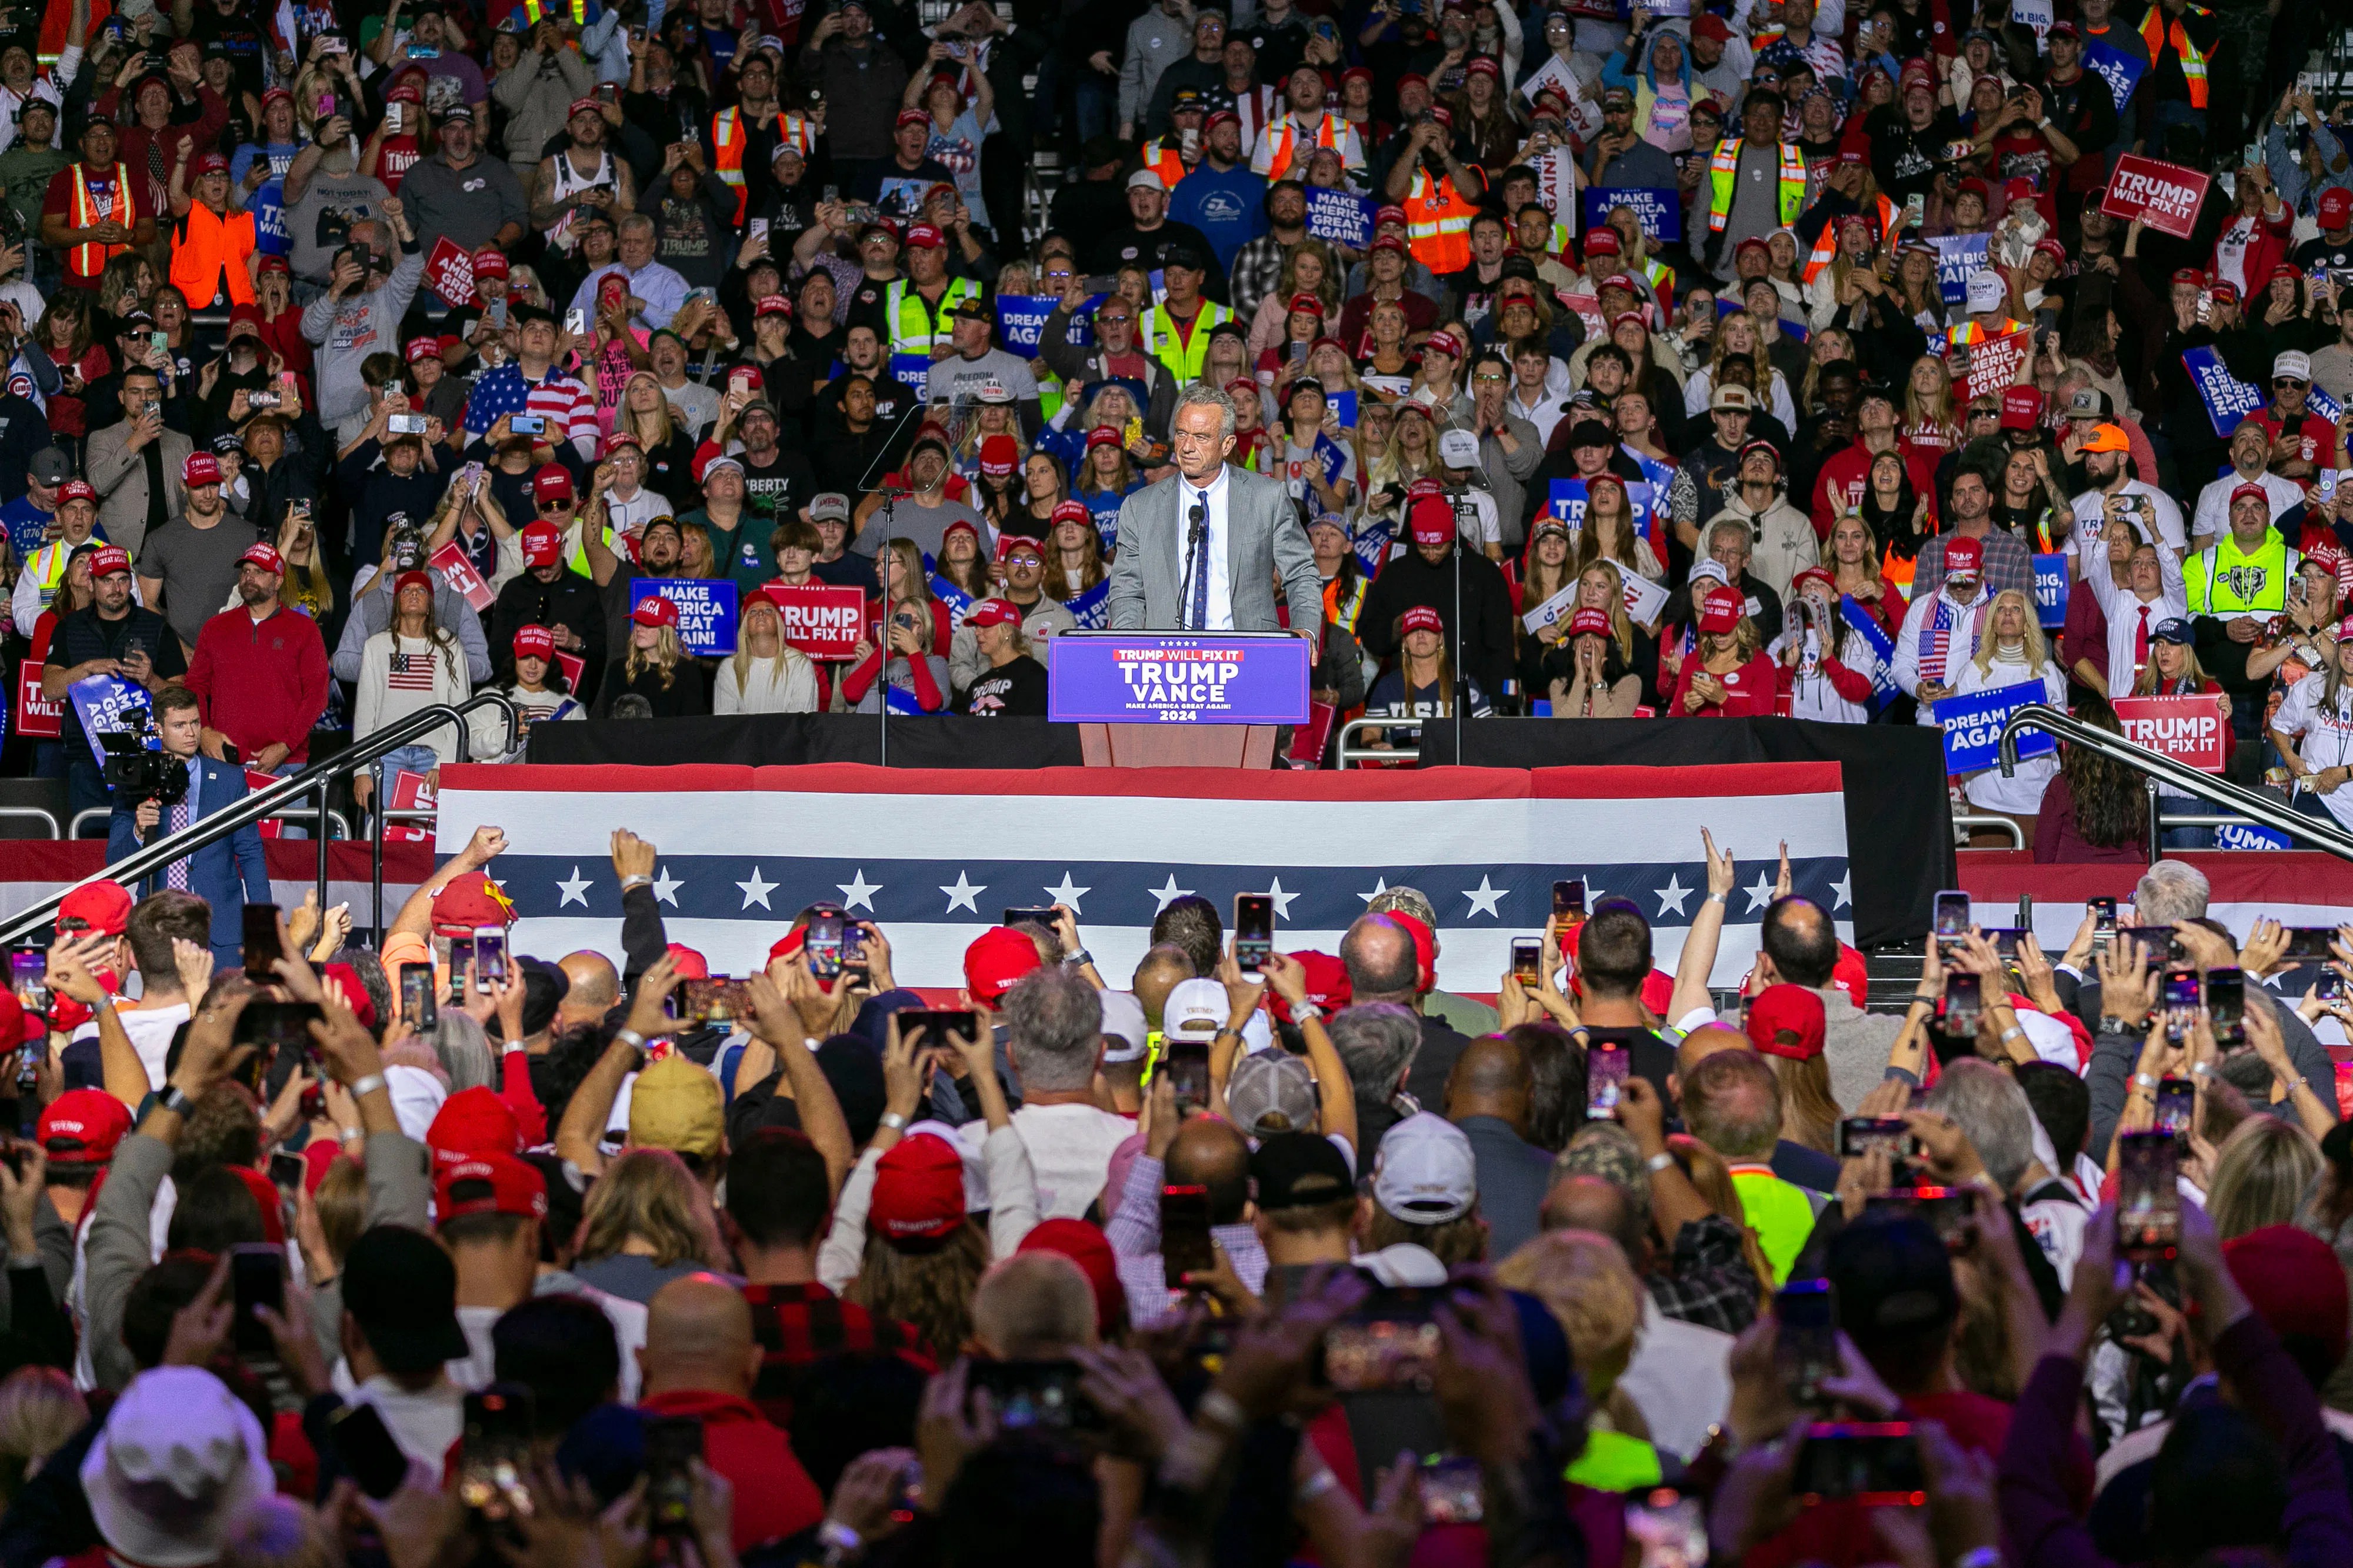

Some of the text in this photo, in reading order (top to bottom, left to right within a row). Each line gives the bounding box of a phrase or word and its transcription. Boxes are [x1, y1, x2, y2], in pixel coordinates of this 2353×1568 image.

[1543, 152, 1557, 216] GAIN!
[2118, 170, 2197, 204] TRUMP
[1317, 194, 1359, 209] MAKE
[1609, 193, 1654, 203] MAKE
[2113, 187, 2191, 219] WILL FIX IT
[1307, 203, 1370, 224] AMERICA
[1311, 215, 1362, 231] GREAT
[1310, 225, 1363, 241] AGAIN!
[662, 238, 708, 251] TRUMP
[455, 253, 472, 269] MA
[1966, 252, 1988, 262] BIG
[438, 257, 474, 286] AMER
[1969, 339, 2011, 361] MAKE
[1969, 350, 2026, 373] MERICA
[896, 370, 926, 382] DRE
[954, 372, 994, 381] FREEDOM
[1967, 361, 2018, 386] GREAT
[601, 378, 625, 388] LOVE
[2212, 363, 2239, 413] GREAT
[2198, 366, 2229, 418] AGAIN!
[190, 457, 215, 466] TRUMP
[819, 496, 844, 507] AMERICA
[23, 528, 39, 539] 1776
[526, 534, 548, 543] Trump
[94, 548, 128, 558] MAKE AMERICA
[255, 543, 275, 556] AMERICA
[255, 551, 270, 561] AGAIN
[1948, 552, 1973, 560] TRUMP
[98, 555, 127, 565] GREAT AGAIN
[1705, 560, 1724, 571] AMERICA
[1708, 566, 1722, 575] AGAIN
[2035, 572, 2064, 589] BIG,
[660, 587, 709, 600] MAKE
[678, 602, 724, 615] ERICA
[1715, 599, 1732, 608] AMERICA
[1587, 610, 1605, 619] AMERICA
[1717, 608, 1729, 616] AGAIN
[678, 617, 714, 630] EAT
[531, 627, 551, 636] AMERICA
[786, 629, 857, 641] ILL FIX IT
[535, 637, 549, 645] AGAIN
[681, 632, 715, 645] AIN!
[1119, 650, 1238, 660] TRUMP WILL FIX IT
[1119, 662, 1239, 684] TRUMP
[1875, 661, 1897, 691] BIG,
[974, 679, 1012, 699] TRUMP
[1133, 683, 1225, 703] VANCE
[26, 702, 64, 716] WILL
[1388, 701, 1453, 718] USA
[1159, 711, 1197, 722] 2024
[1943, 711, 2006, 733] DREAM
[2121, 716, 2217, 740] TRUMP
[2133, 737, 2215, 753] ILL FIX IT
[2214, 825, 2282, 849] RUMP
[1305, 993, 1327, 1003] UMP
[49, 1119, 84, 1133] TRUMP
